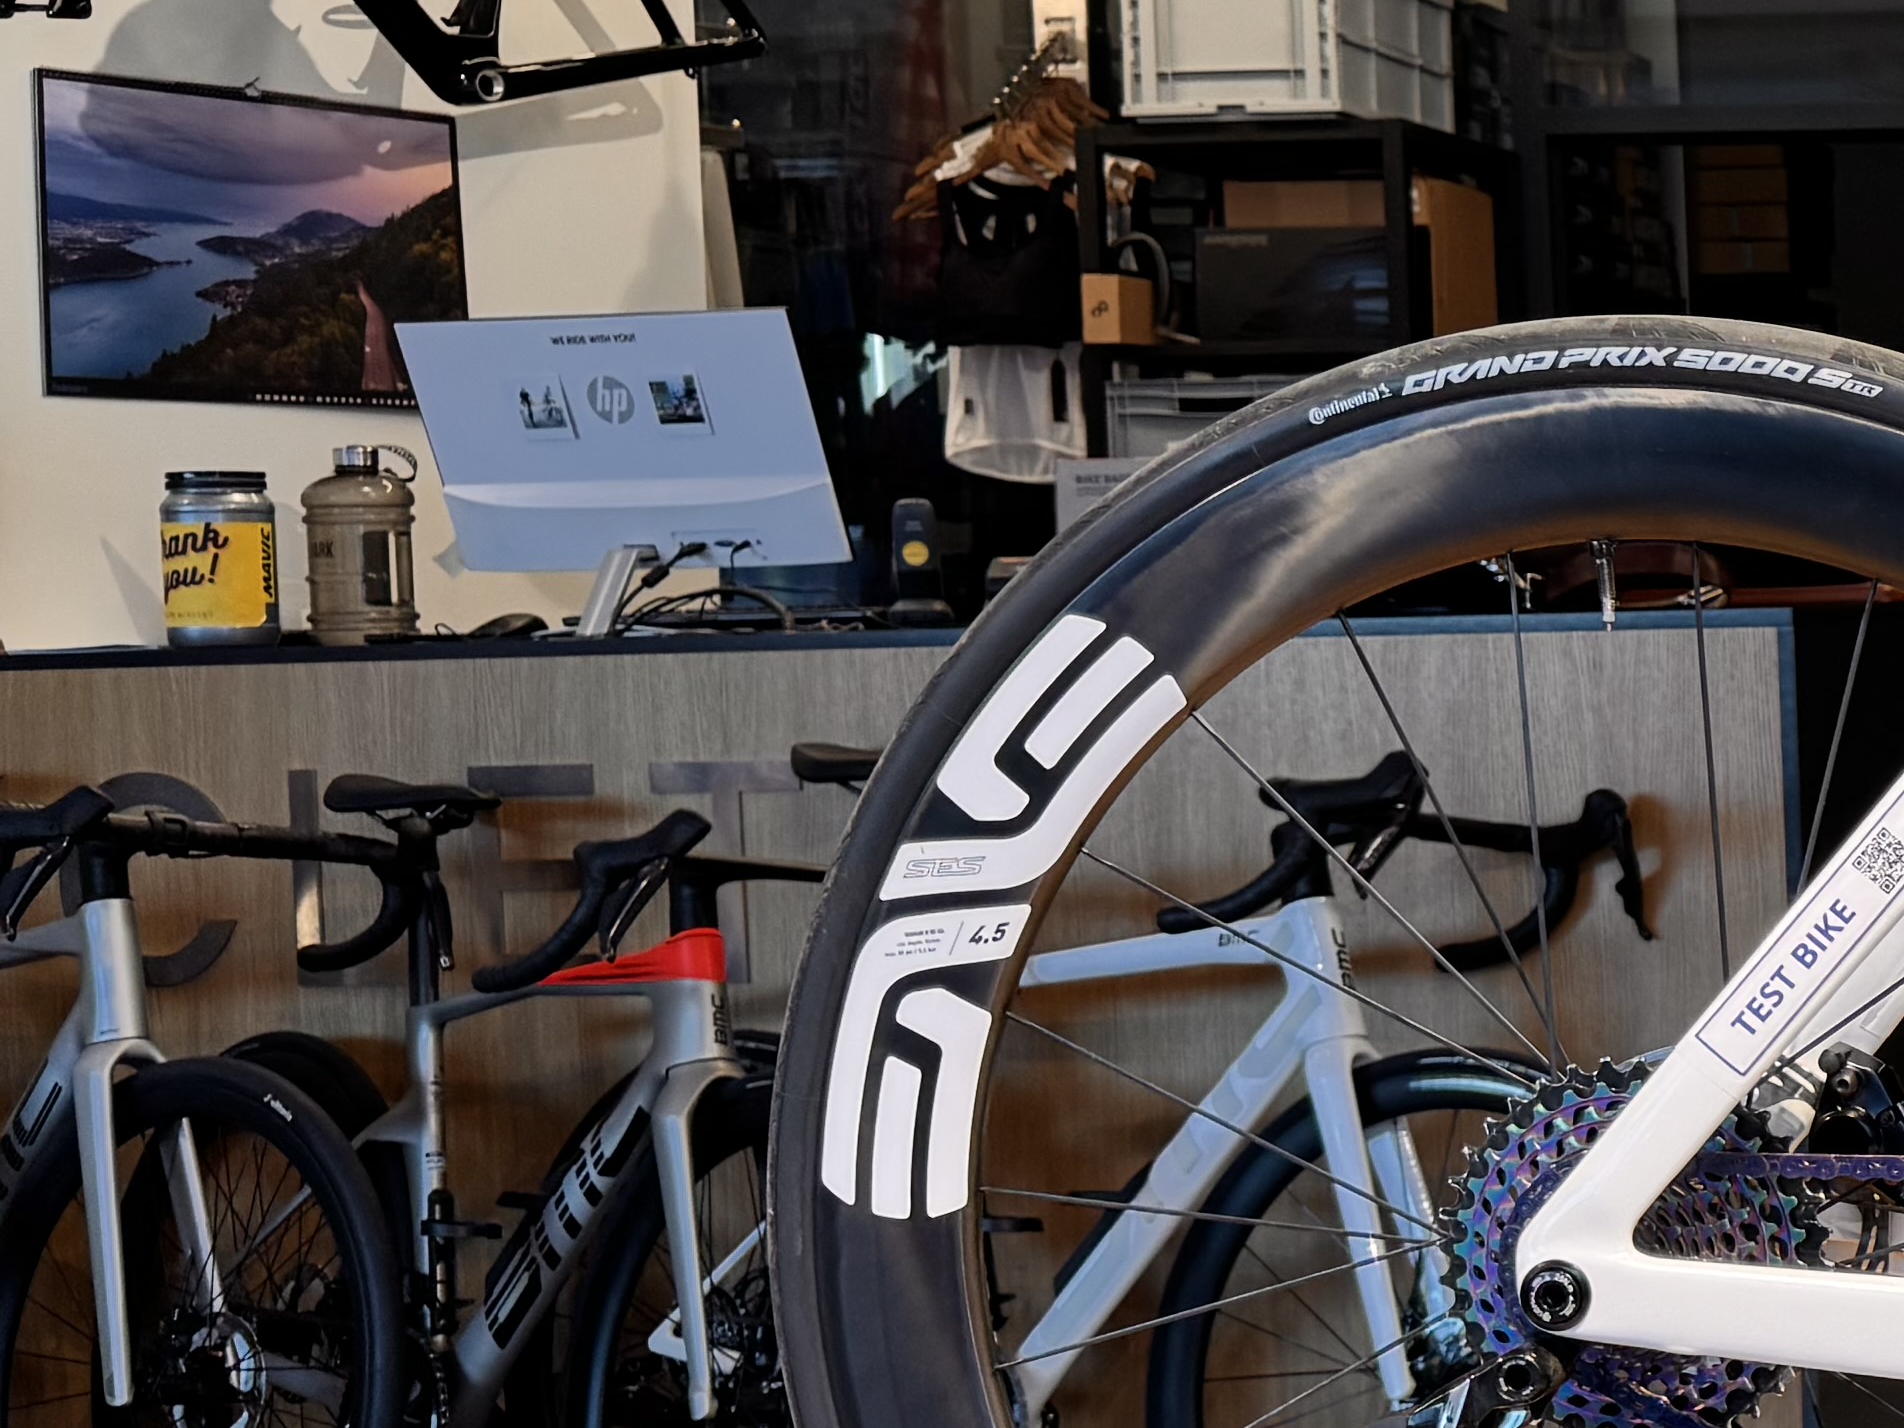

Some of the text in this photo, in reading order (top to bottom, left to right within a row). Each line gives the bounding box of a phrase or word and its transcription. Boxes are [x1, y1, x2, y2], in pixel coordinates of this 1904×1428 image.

[591, 375, 633, 425] hp
[1308, 383, 1381, 426] Continental
[1401, 349, 1560, 397] GRAND
[1558, 345, 1681, 370] PRIX
[1674, 349, 1817, 382] 5000
[260, 527, 274, 598] MAVIC
[903, 856, 987, 879] SES
[968, 922, 1011, 946] 4.5
[1730, 964, 1797, 1037] TEST
[1790, 898, 1857, 971] BIKE
